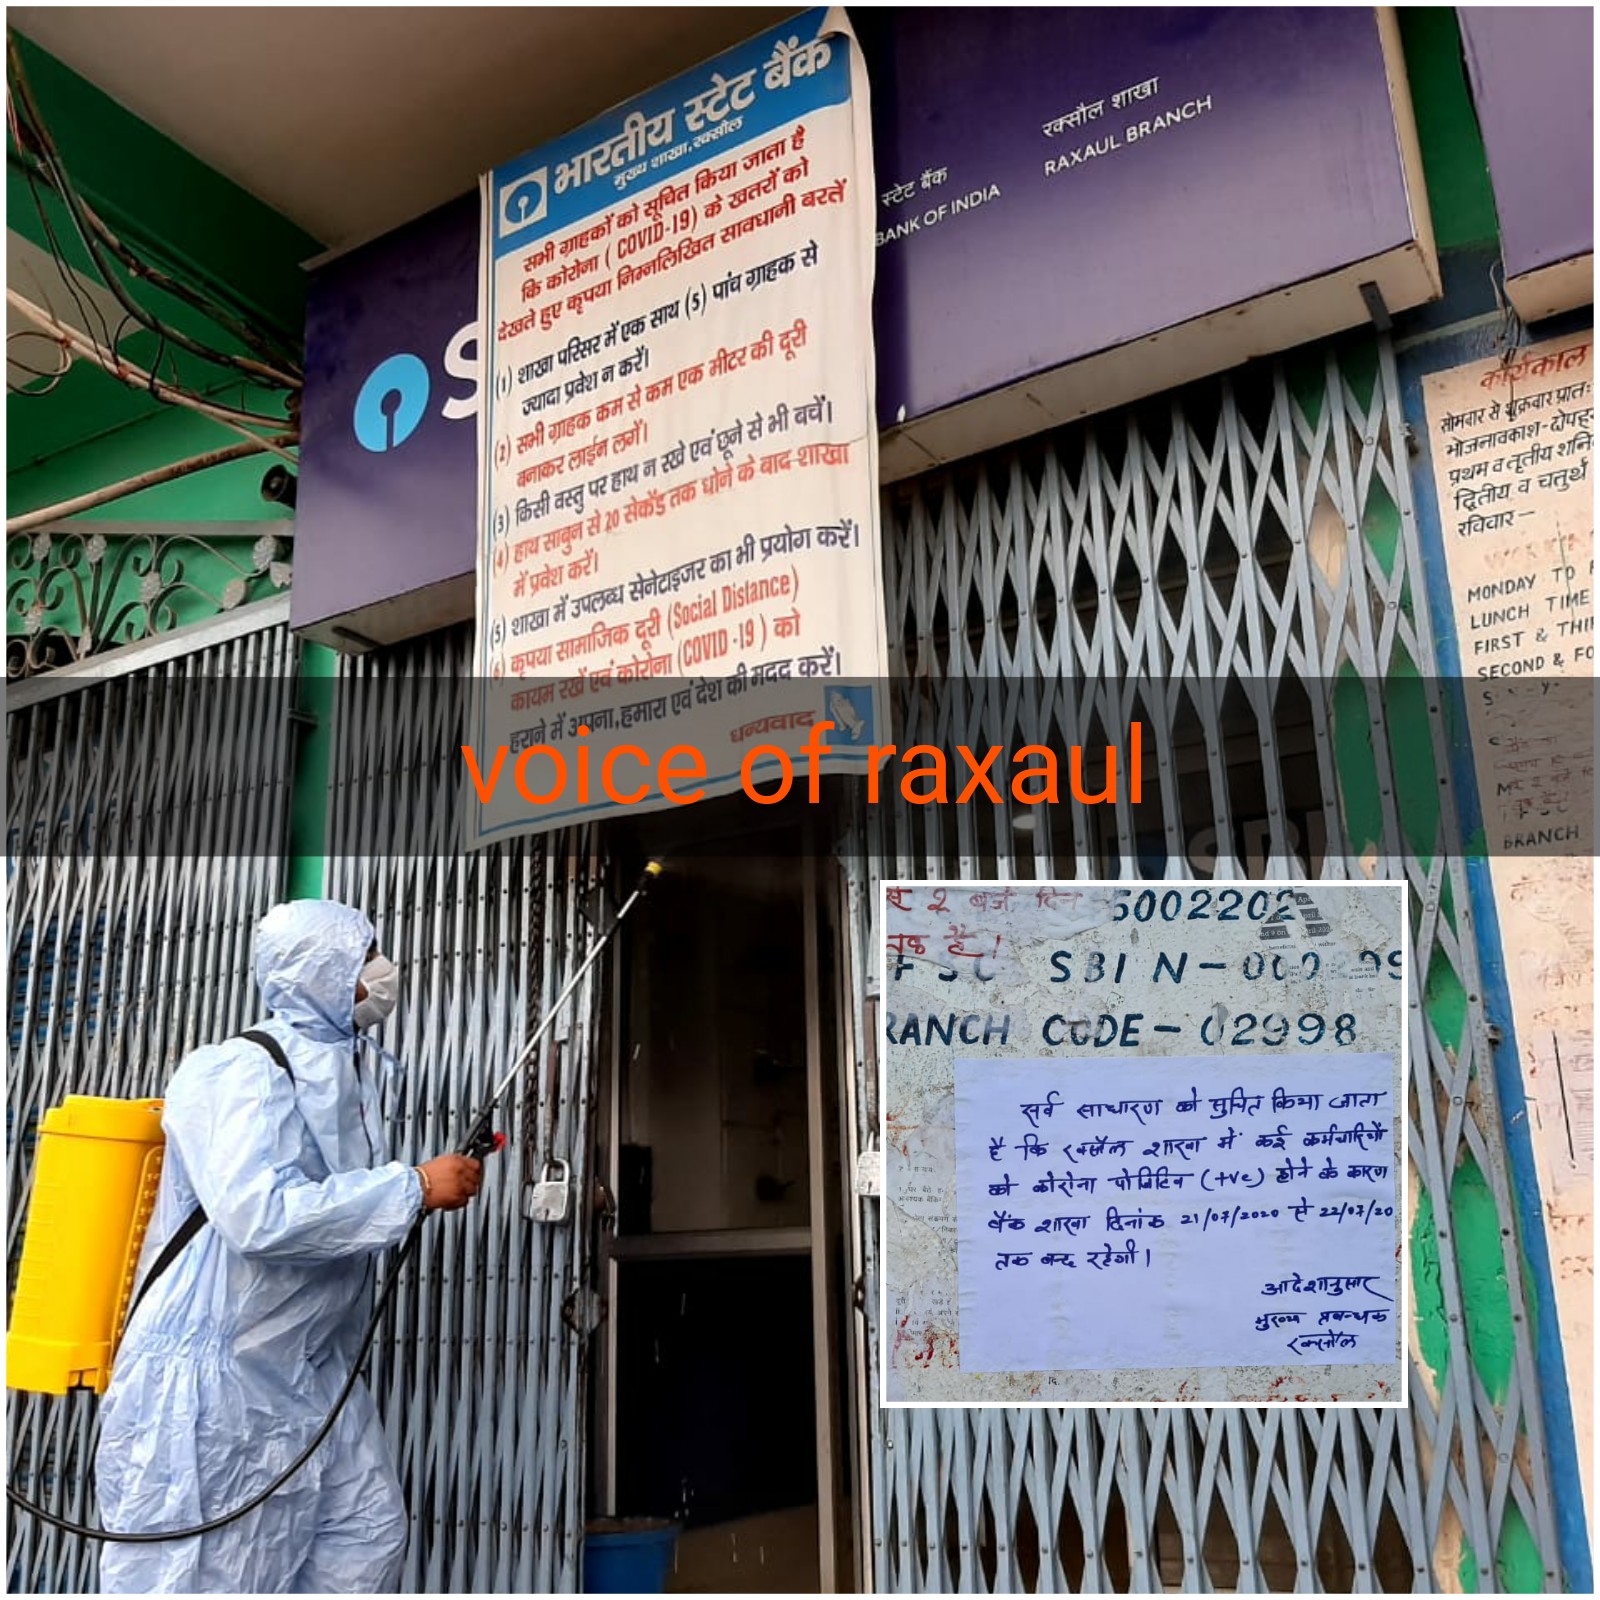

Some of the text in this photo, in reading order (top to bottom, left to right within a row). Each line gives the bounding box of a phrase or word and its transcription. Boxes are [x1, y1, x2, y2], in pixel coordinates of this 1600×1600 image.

[554, 35, 832, 194] भारतीय स्टेट बैंक
[1042, 75, 1160, 138] रक्सौल शाखा
[1043, 93, 1213, 177] RAXAUL BRANCH
[523, 124, 806, 273] सभी ग्राहकों को किया जाता है
[614, 162, 648, 190] मुख्य
[881, 165, 948, 208] स्टेट बैंक
[521, 156, 809, 303] कि कोरोना के खतरों को
[875, 184, 1001, 247] BANK OF INDIA
[497, 178, 847, 342] देखते हुए कृपया निम्नलिखित सावधानी बरतें
[518, 240, 818, 384] शाखा परिसर में एक साथ (5) पांच ग्राहक से
[516, 318, 808, 454] सभी ग्राहक कम से कम एक मीटर की दूरी
[522, 367, 615, 417] ज्यादा प्रवेश न
[1440, 402, 1501, 433] सोमवार से
[515, 403, 790, 527] किसी वस्तु पर हाथ न एवं छूने से भी
[517, 435, 609, 488] बनाकर लाईन
[1449, 444, 1553, 487] प्रथम व तृतीय
[1454, 458, 1588, 512] द्वितीय व चतुर्थ
[513, 442, 850, 563] हाथ साबुन से 20 तक धोने के बाद शाखा
[511, 524, 812, 637] शाखा में उपलब्ध का भी प्रयोग
[513, 563, 563, 598] में प्रवेश
[1468, 574, 1536, 603] MONDAY
[1551, 566, 1575, 582] TO
[510, 564, 799, 681] कृपया सामाजिक दूरी (Social Distance)
[1471, 589, 1590, 630] LUNCH TIME
[511, 606, 801, 712] कायम रखें एवं कोरोना को
[1474, 631, 1526, 656] FIRST
[1535, 627, 1548, 643] &
[1478, 656, 1545, 683] SECOND
[1553, 652, 1565, 667] &
[551, 659, 793, 741] में एवं देश की मदद
[730, 709, 816, 743] धन्यवाद
[1503, 824, 1579, 850] BRANCH
[1020, 1086, 1388, 1128] सर्व साधारण को किया जाता
[988, 1136, 1007, 1161] है
[1014, 1133, 1049, 1160] कि
[1143, 1137, 1207, 1160] शाखा
[1217, 1126, 1243, 1150] में
[1255, 1124, 1293, 1150] कई
[988, 1173, 1020, 1196] को
[1032, 1171, 1097, 1198] कोरोना
[1275, 1156, 1313, 1184] होने
[1318, 1156, 1338, 1180] के
[1347, 1164, 1388, 1183] कारण
[987, 1196, 1394, 1236] बैंक शाखा दिनांक 21/07/2020 से 22/07/20
[995, 1252, 1033, 1270] तक
